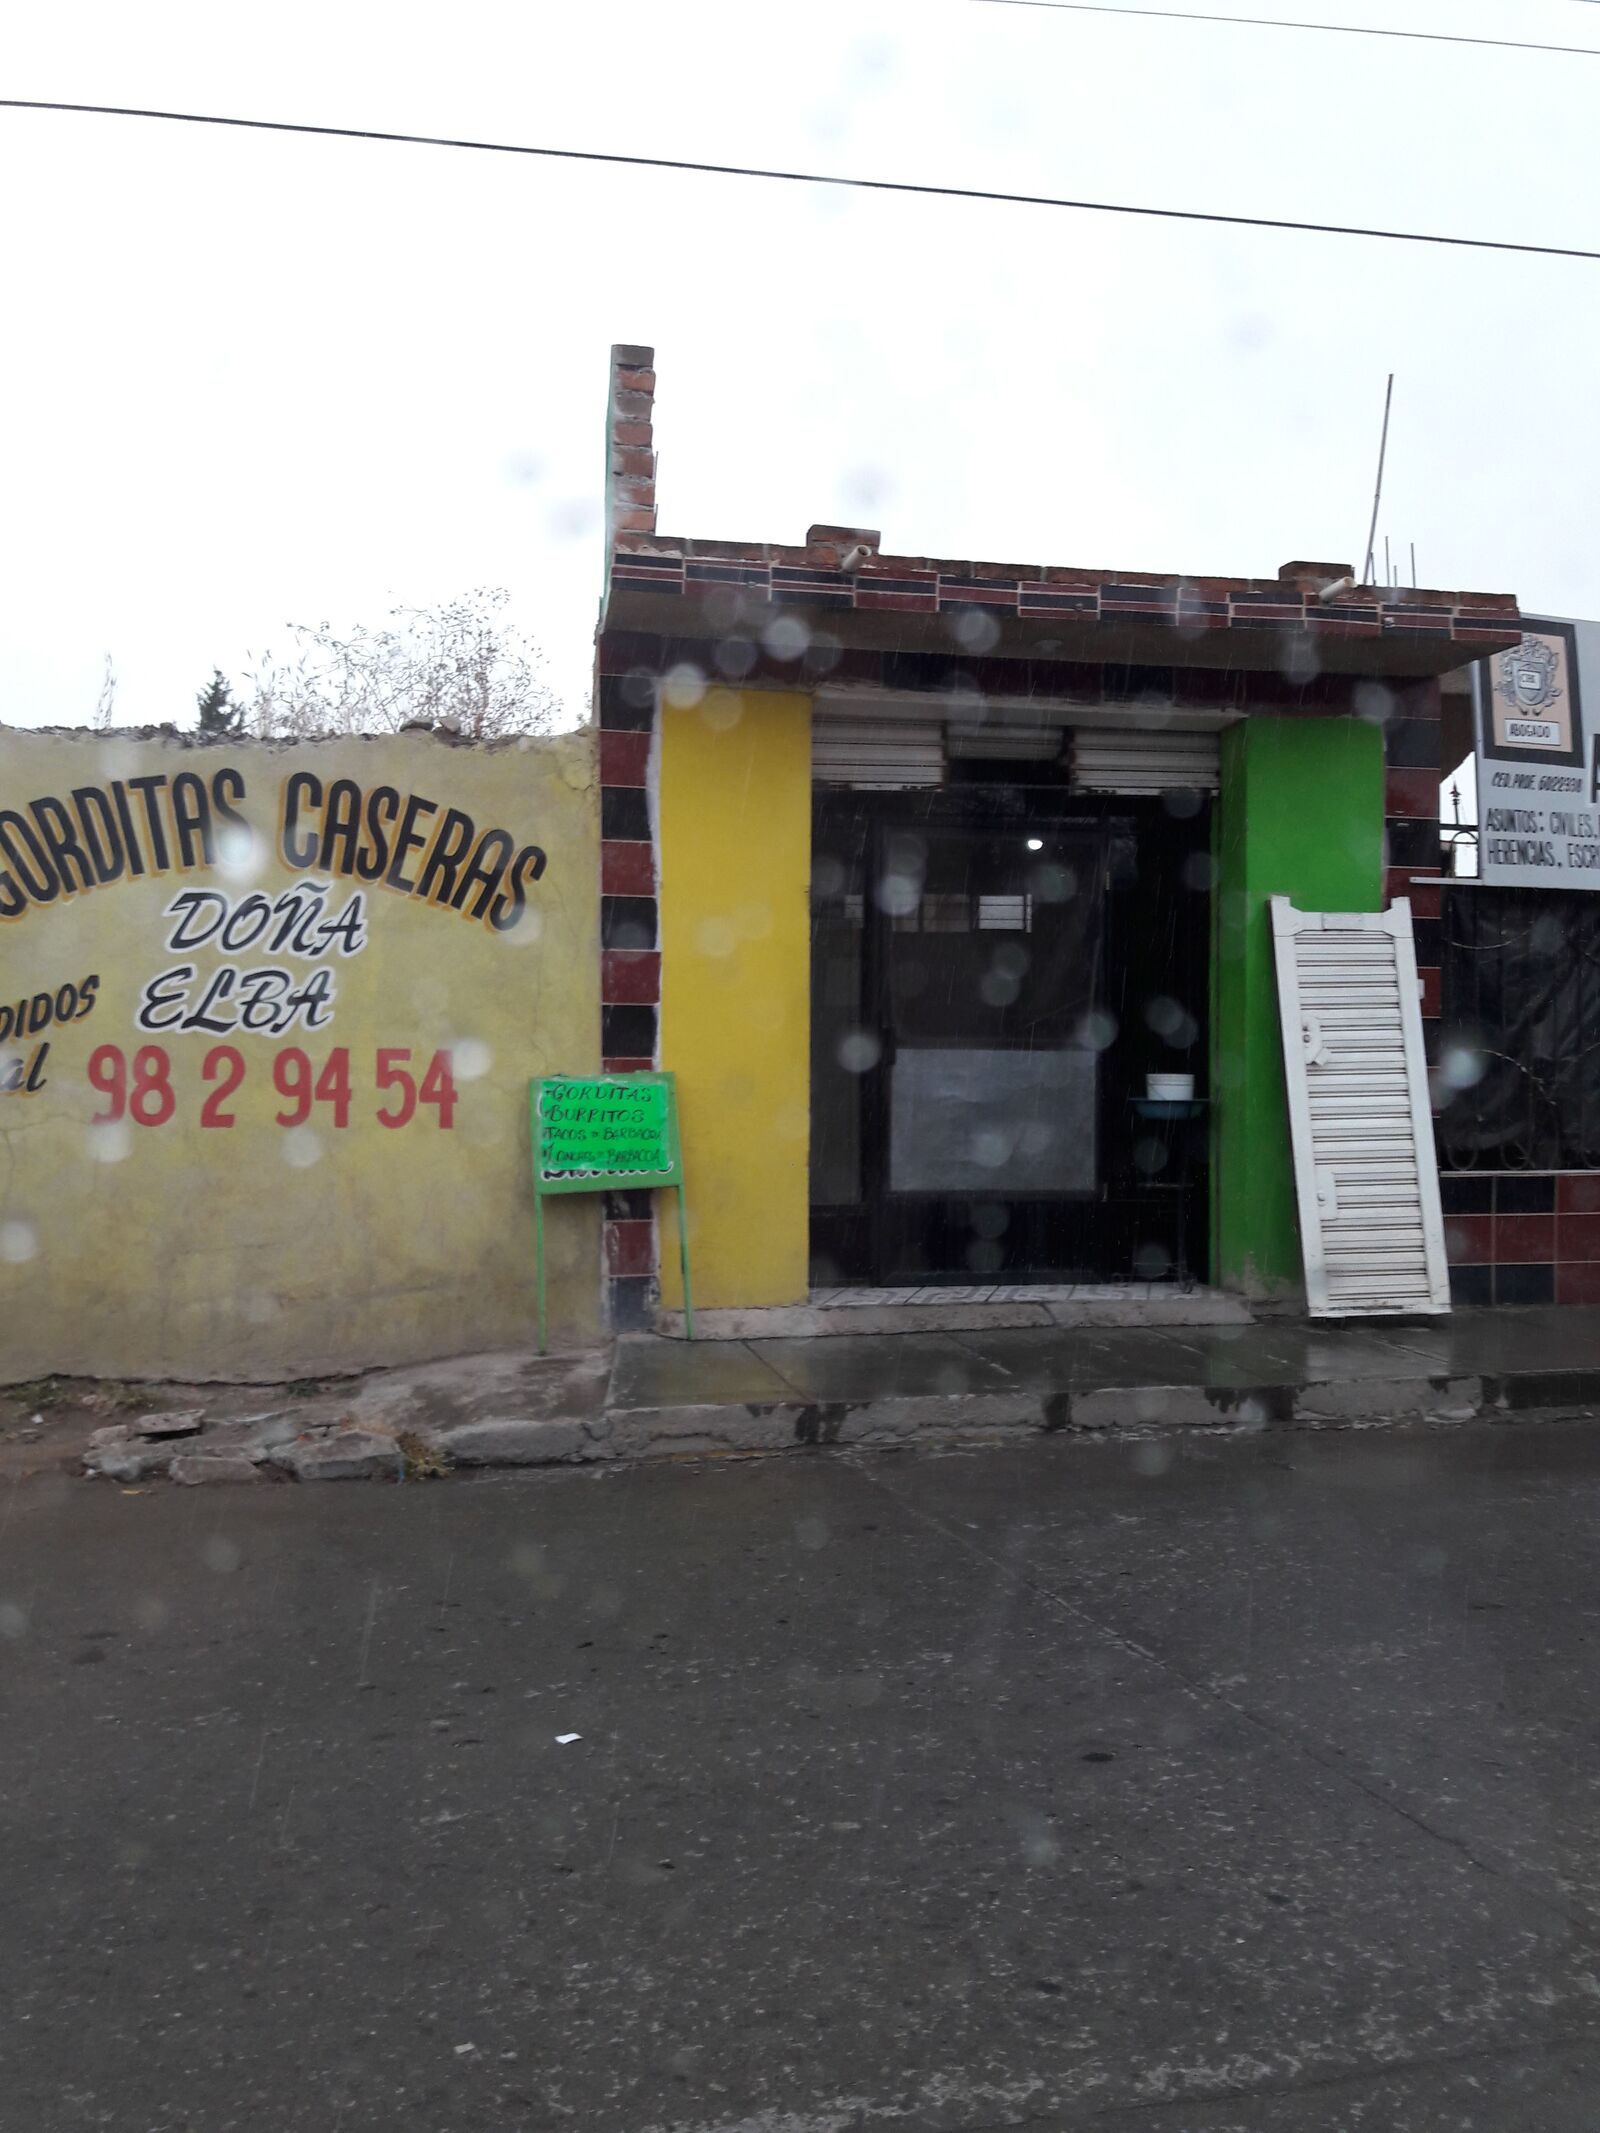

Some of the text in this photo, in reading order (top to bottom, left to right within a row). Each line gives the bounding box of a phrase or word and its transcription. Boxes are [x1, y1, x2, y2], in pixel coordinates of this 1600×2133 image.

[1509, 723, 1551, 738] ABOGADO
[283, 771, 547, 931] CASERAS
[169, 881, 364, 957] DOÑA
[139, 966, 332, 1034] ELBA
[87, 1044, 459, 1130] 98 2 94 54
